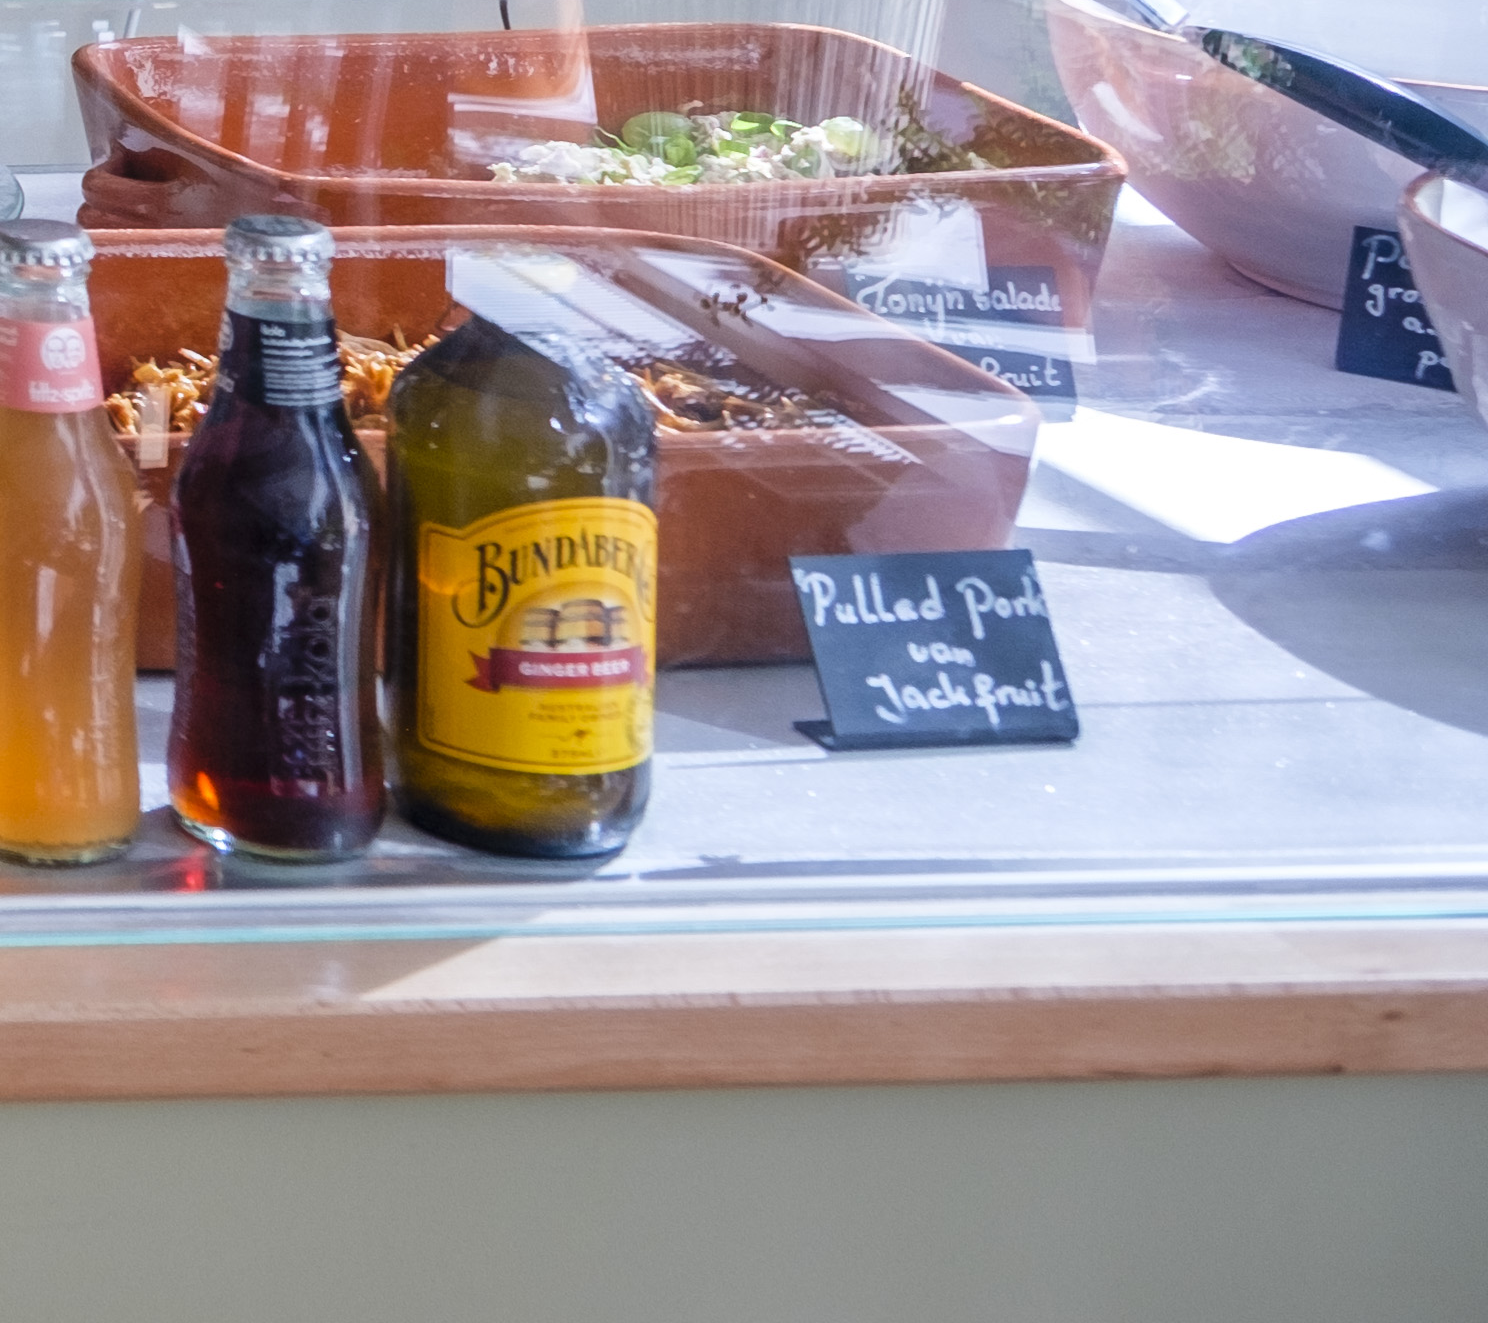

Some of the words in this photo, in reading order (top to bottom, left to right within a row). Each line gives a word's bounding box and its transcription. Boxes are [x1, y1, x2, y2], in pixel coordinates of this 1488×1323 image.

[804, 571, 946, 627] Pulled
[955, 575, 1050, 640] Pork
[518, 660, 590, 677] GINGER
[592, 658, 632, 676] BEER
[907, 642, 976, 668] van
[866, 659, 1069, 728] Jackfruit
